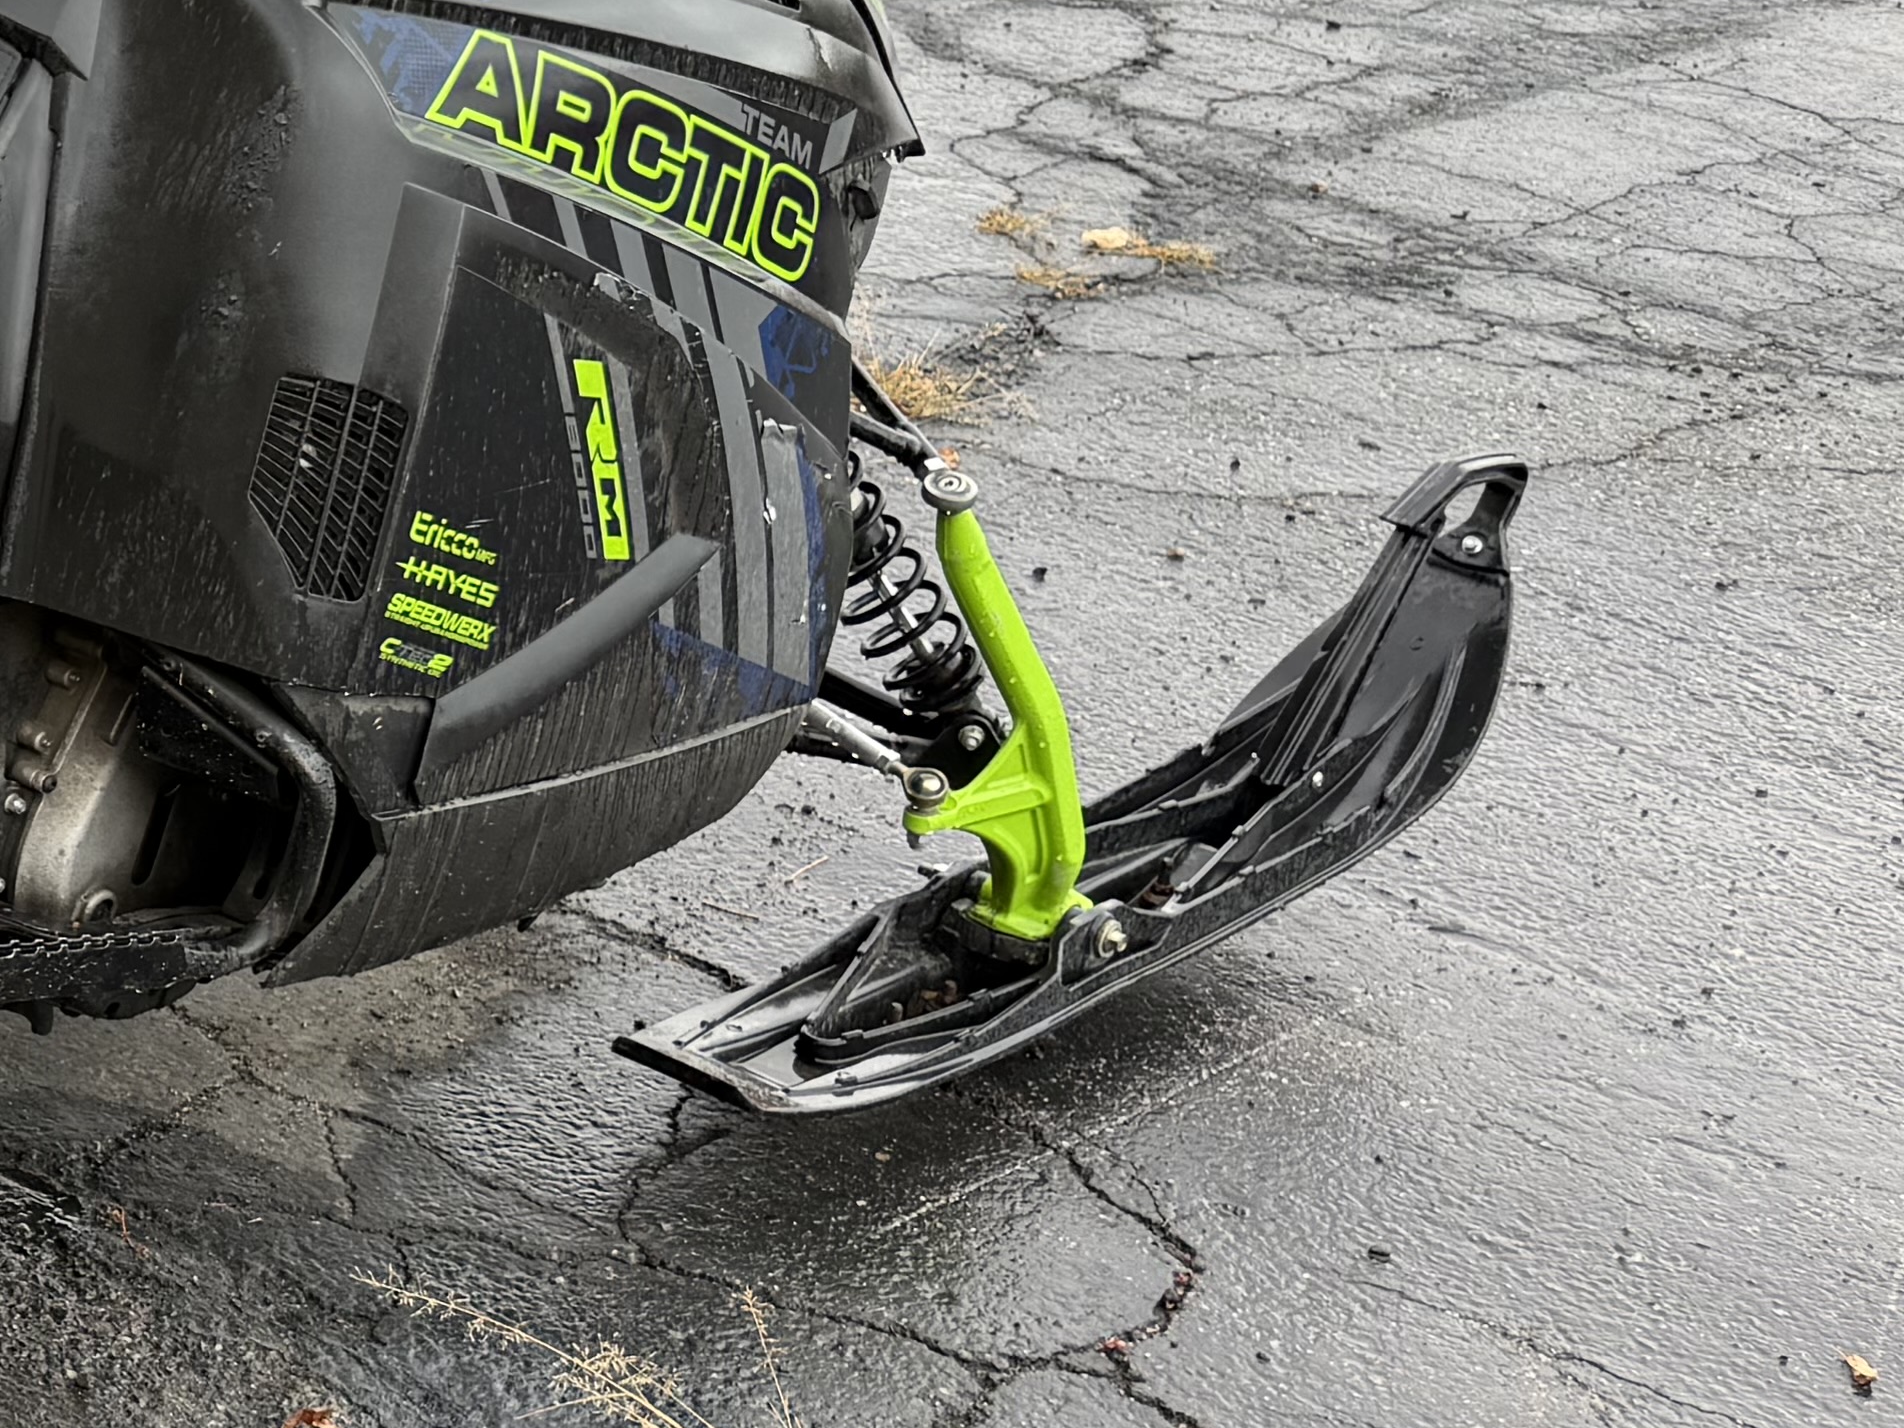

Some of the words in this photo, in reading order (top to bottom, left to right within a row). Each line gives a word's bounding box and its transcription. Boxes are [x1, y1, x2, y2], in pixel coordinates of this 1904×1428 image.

[425, 28, 820, 282] ARCTIC
[741, 101, 813, 170] TEAM
[409, 510, 480, 560] Ericco
[395, 555, 500, 609] HAYES
[386, 592, 496, 642] SPEEDWERX
